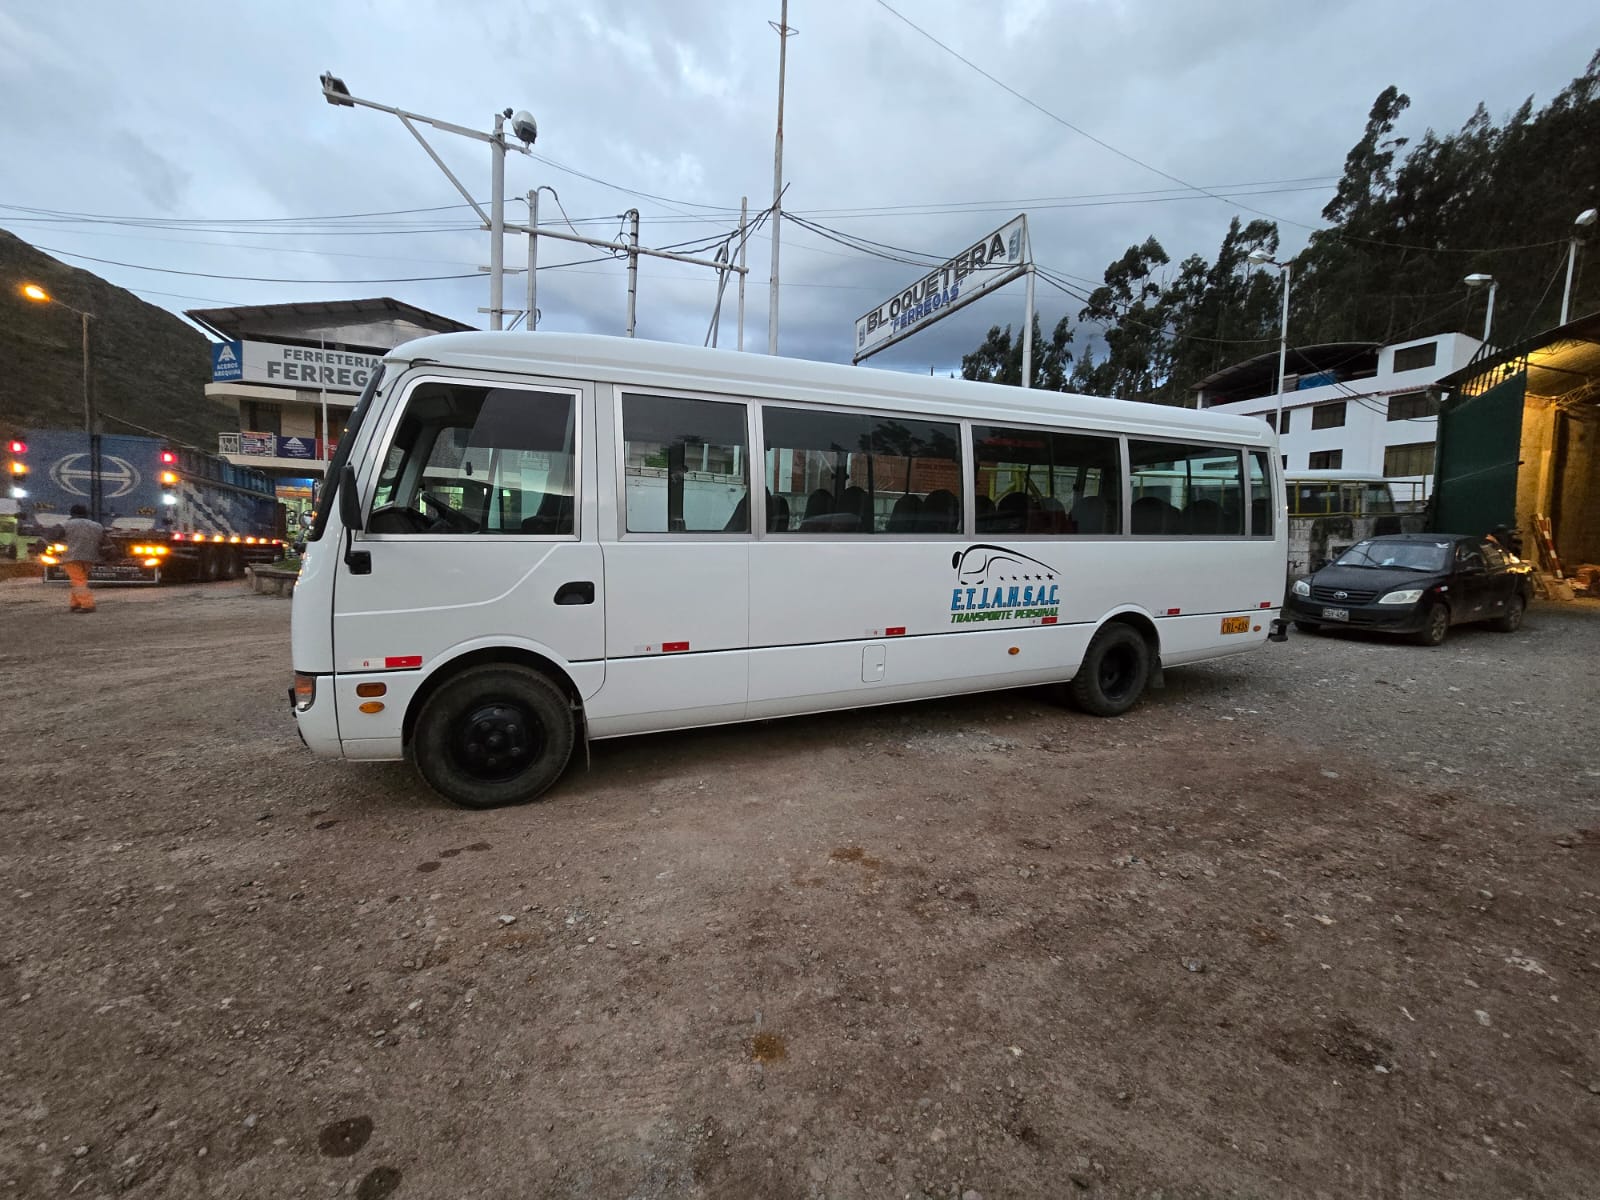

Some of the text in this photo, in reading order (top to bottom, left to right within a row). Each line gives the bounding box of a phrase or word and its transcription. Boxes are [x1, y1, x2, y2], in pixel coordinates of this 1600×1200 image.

[867, 233, 1006, 335] BLOQUETERA
[283, 348, 379, 369] FERRETERIA
[267, 360, 374, 387] FERREG
[951, 607, 1059, 623] TRANSPORTE PERSONAL
